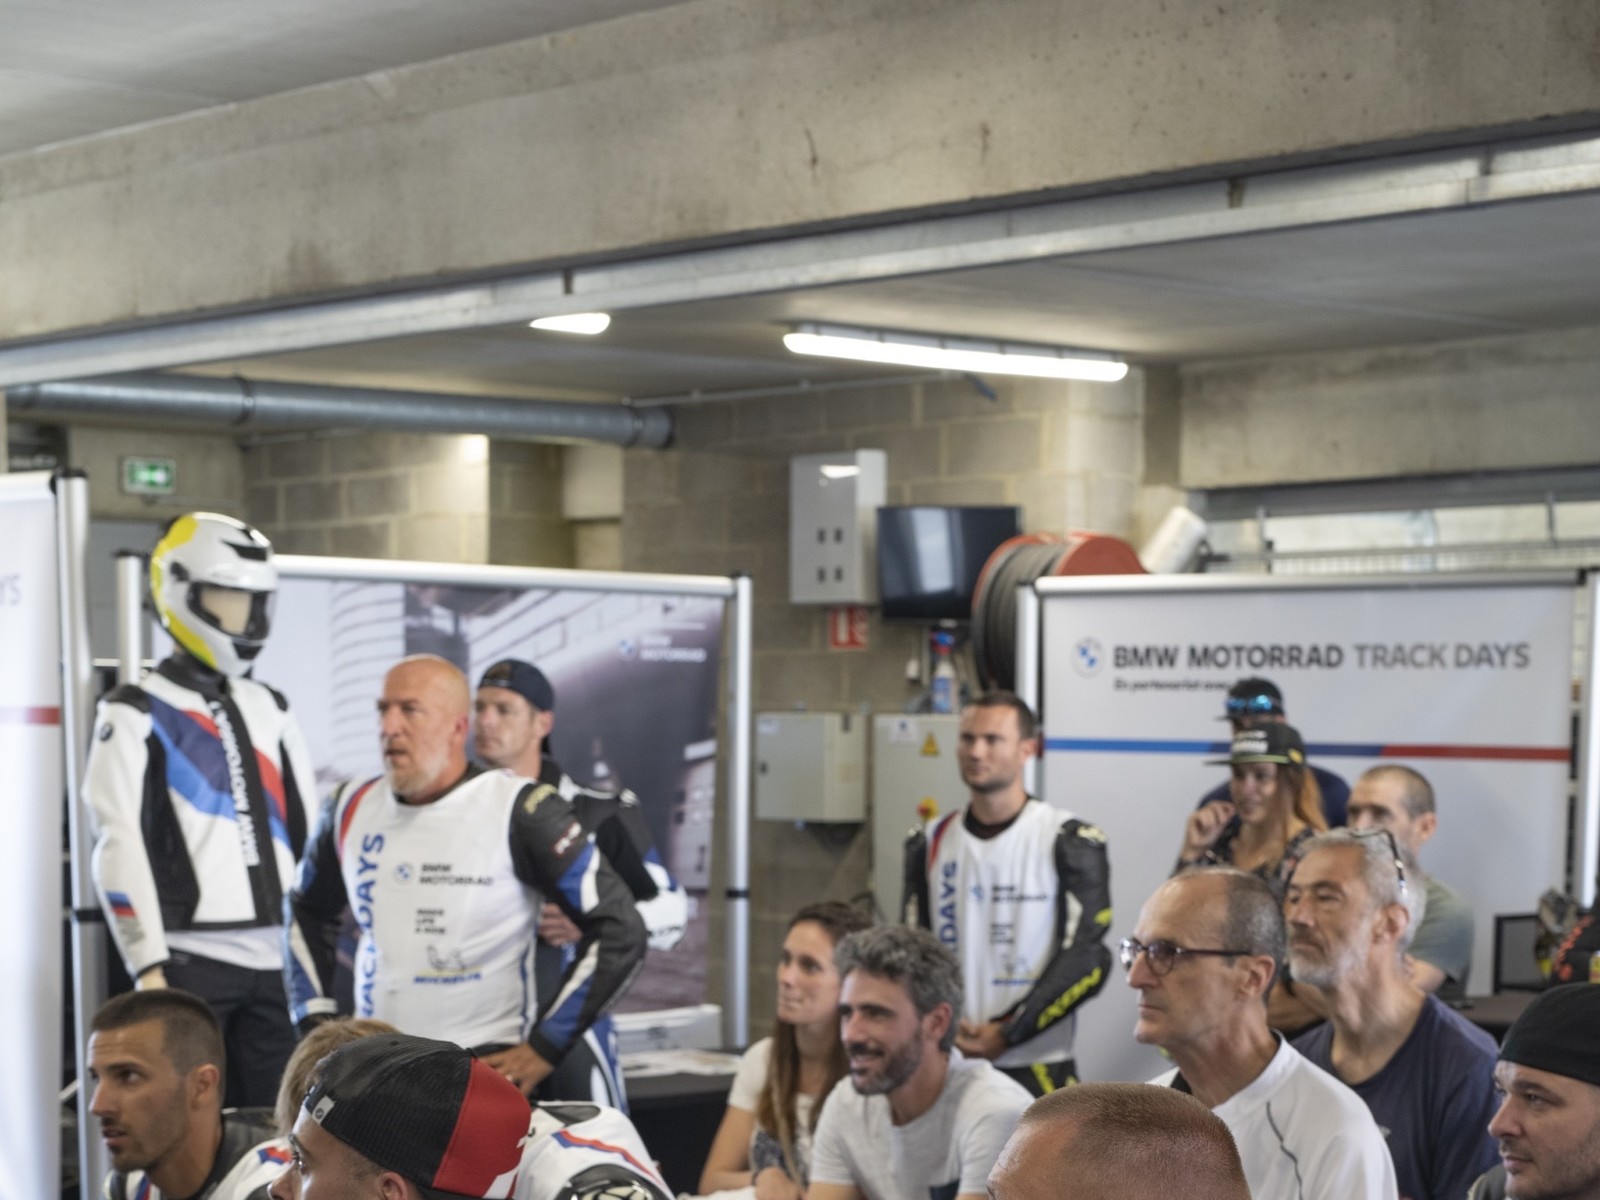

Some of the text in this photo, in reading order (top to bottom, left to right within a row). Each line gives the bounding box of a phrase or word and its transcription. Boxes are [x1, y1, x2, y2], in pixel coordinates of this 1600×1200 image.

[1113, 644, 1530, 669] BMW MOTORRAD TRACK DAYS
[940, 861, 958, 943] DAYS
